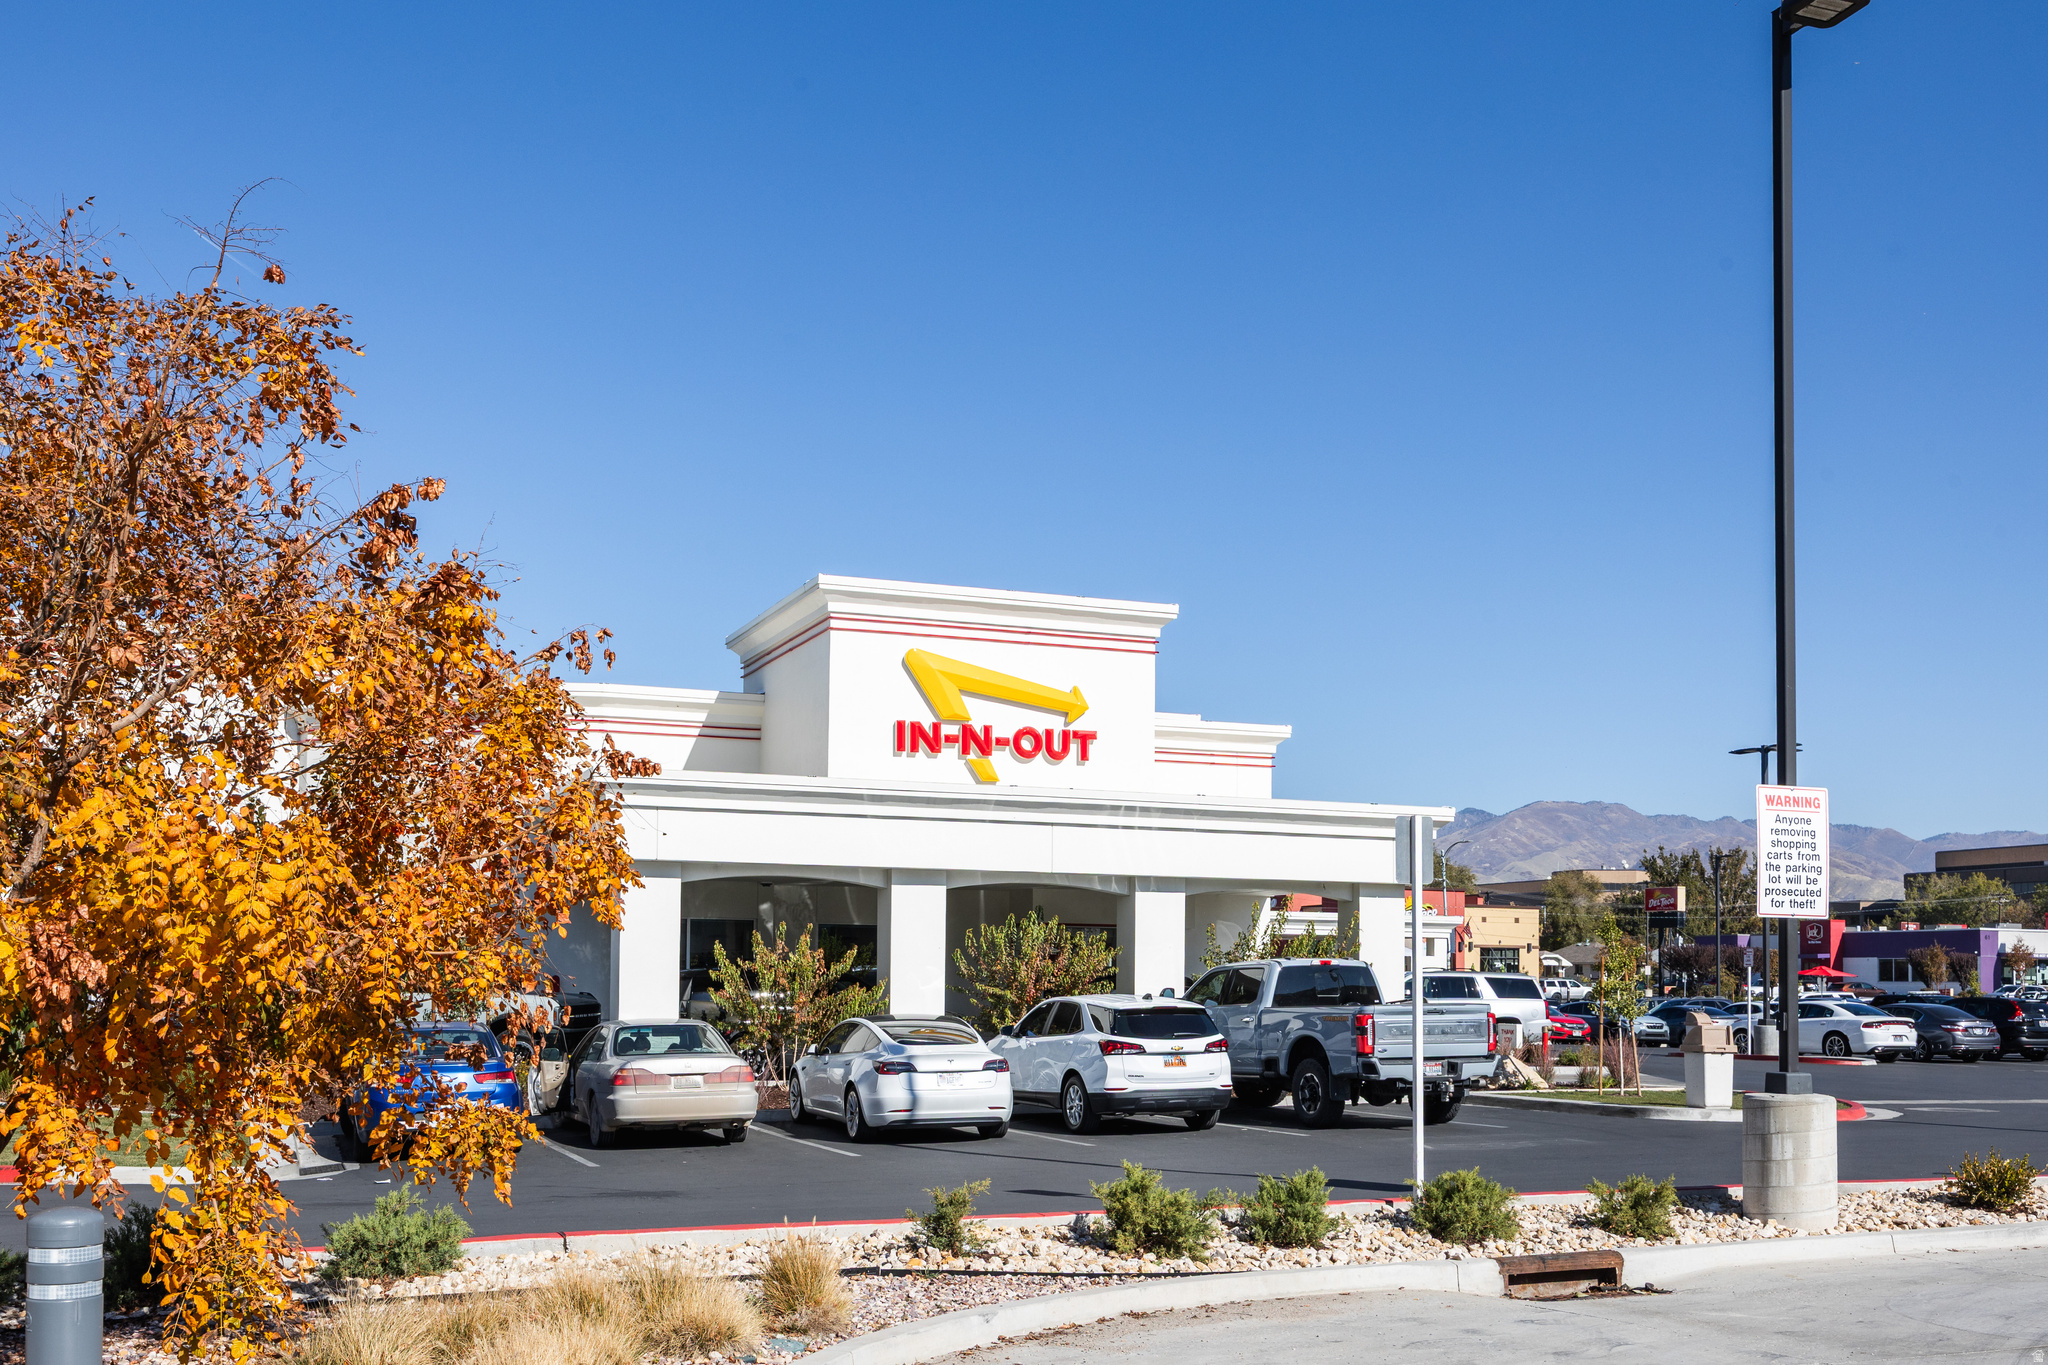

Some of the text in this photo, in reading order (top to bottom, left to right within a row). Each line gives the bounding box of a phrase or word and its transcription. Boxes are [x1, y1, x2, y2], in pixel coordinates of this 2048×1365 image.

[895, 719, 1097, 763] IN-N-OUT
[1765, 794, 1820, 809] WARNING
[1774, 814, 1812, 826] Anyone
[1770, 827, 1816, 839] removing
[1770, 838, 1816, 851] shopping
[1767, 851, 1820, 861] carts from
[1765, 862, 1822, 875] the parking
[1768, 874, 1818, 885] lot will be
[1765, 887, 1822, 898] prosecuted
[1771, 898, 1816, 909] for theft!
